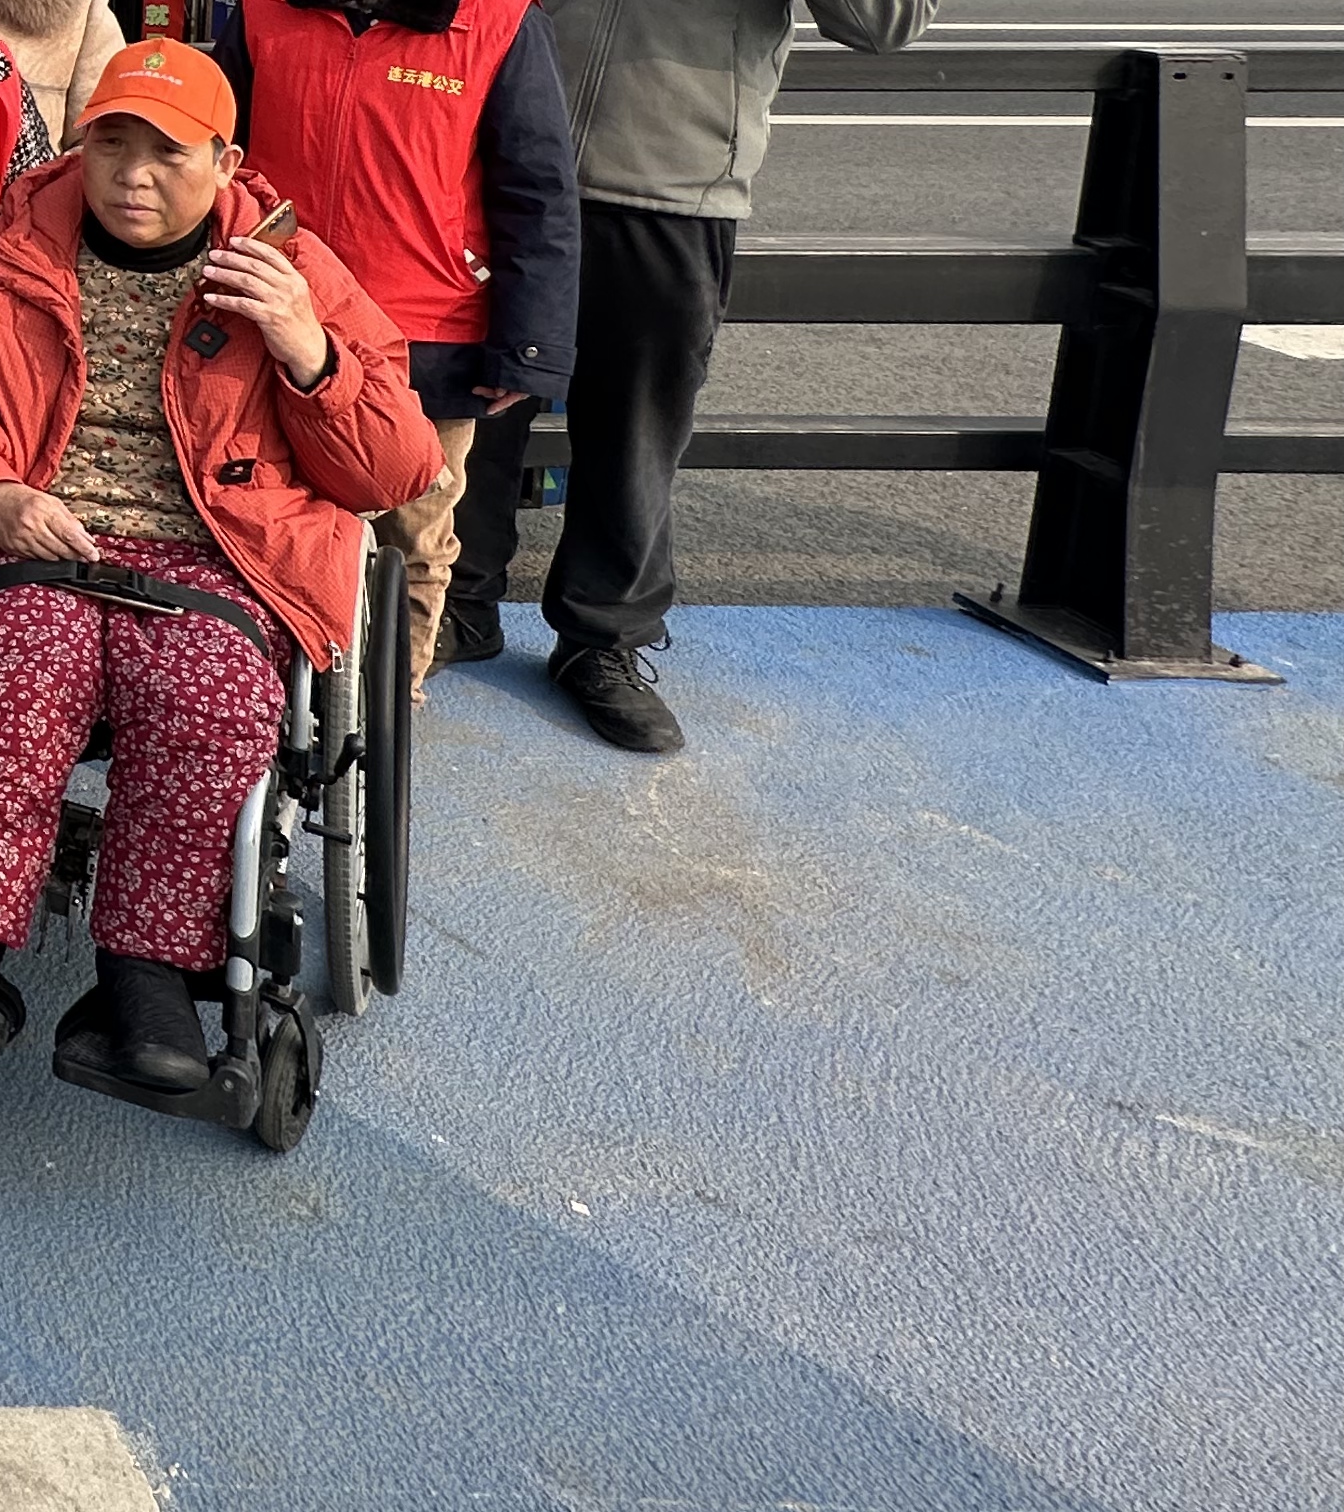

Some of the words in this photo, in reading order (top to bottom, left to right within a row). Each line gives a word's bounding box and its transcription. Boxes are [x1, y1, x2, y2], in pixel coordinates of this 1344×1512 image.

[387, 65, 465, 96] 连云港公交
